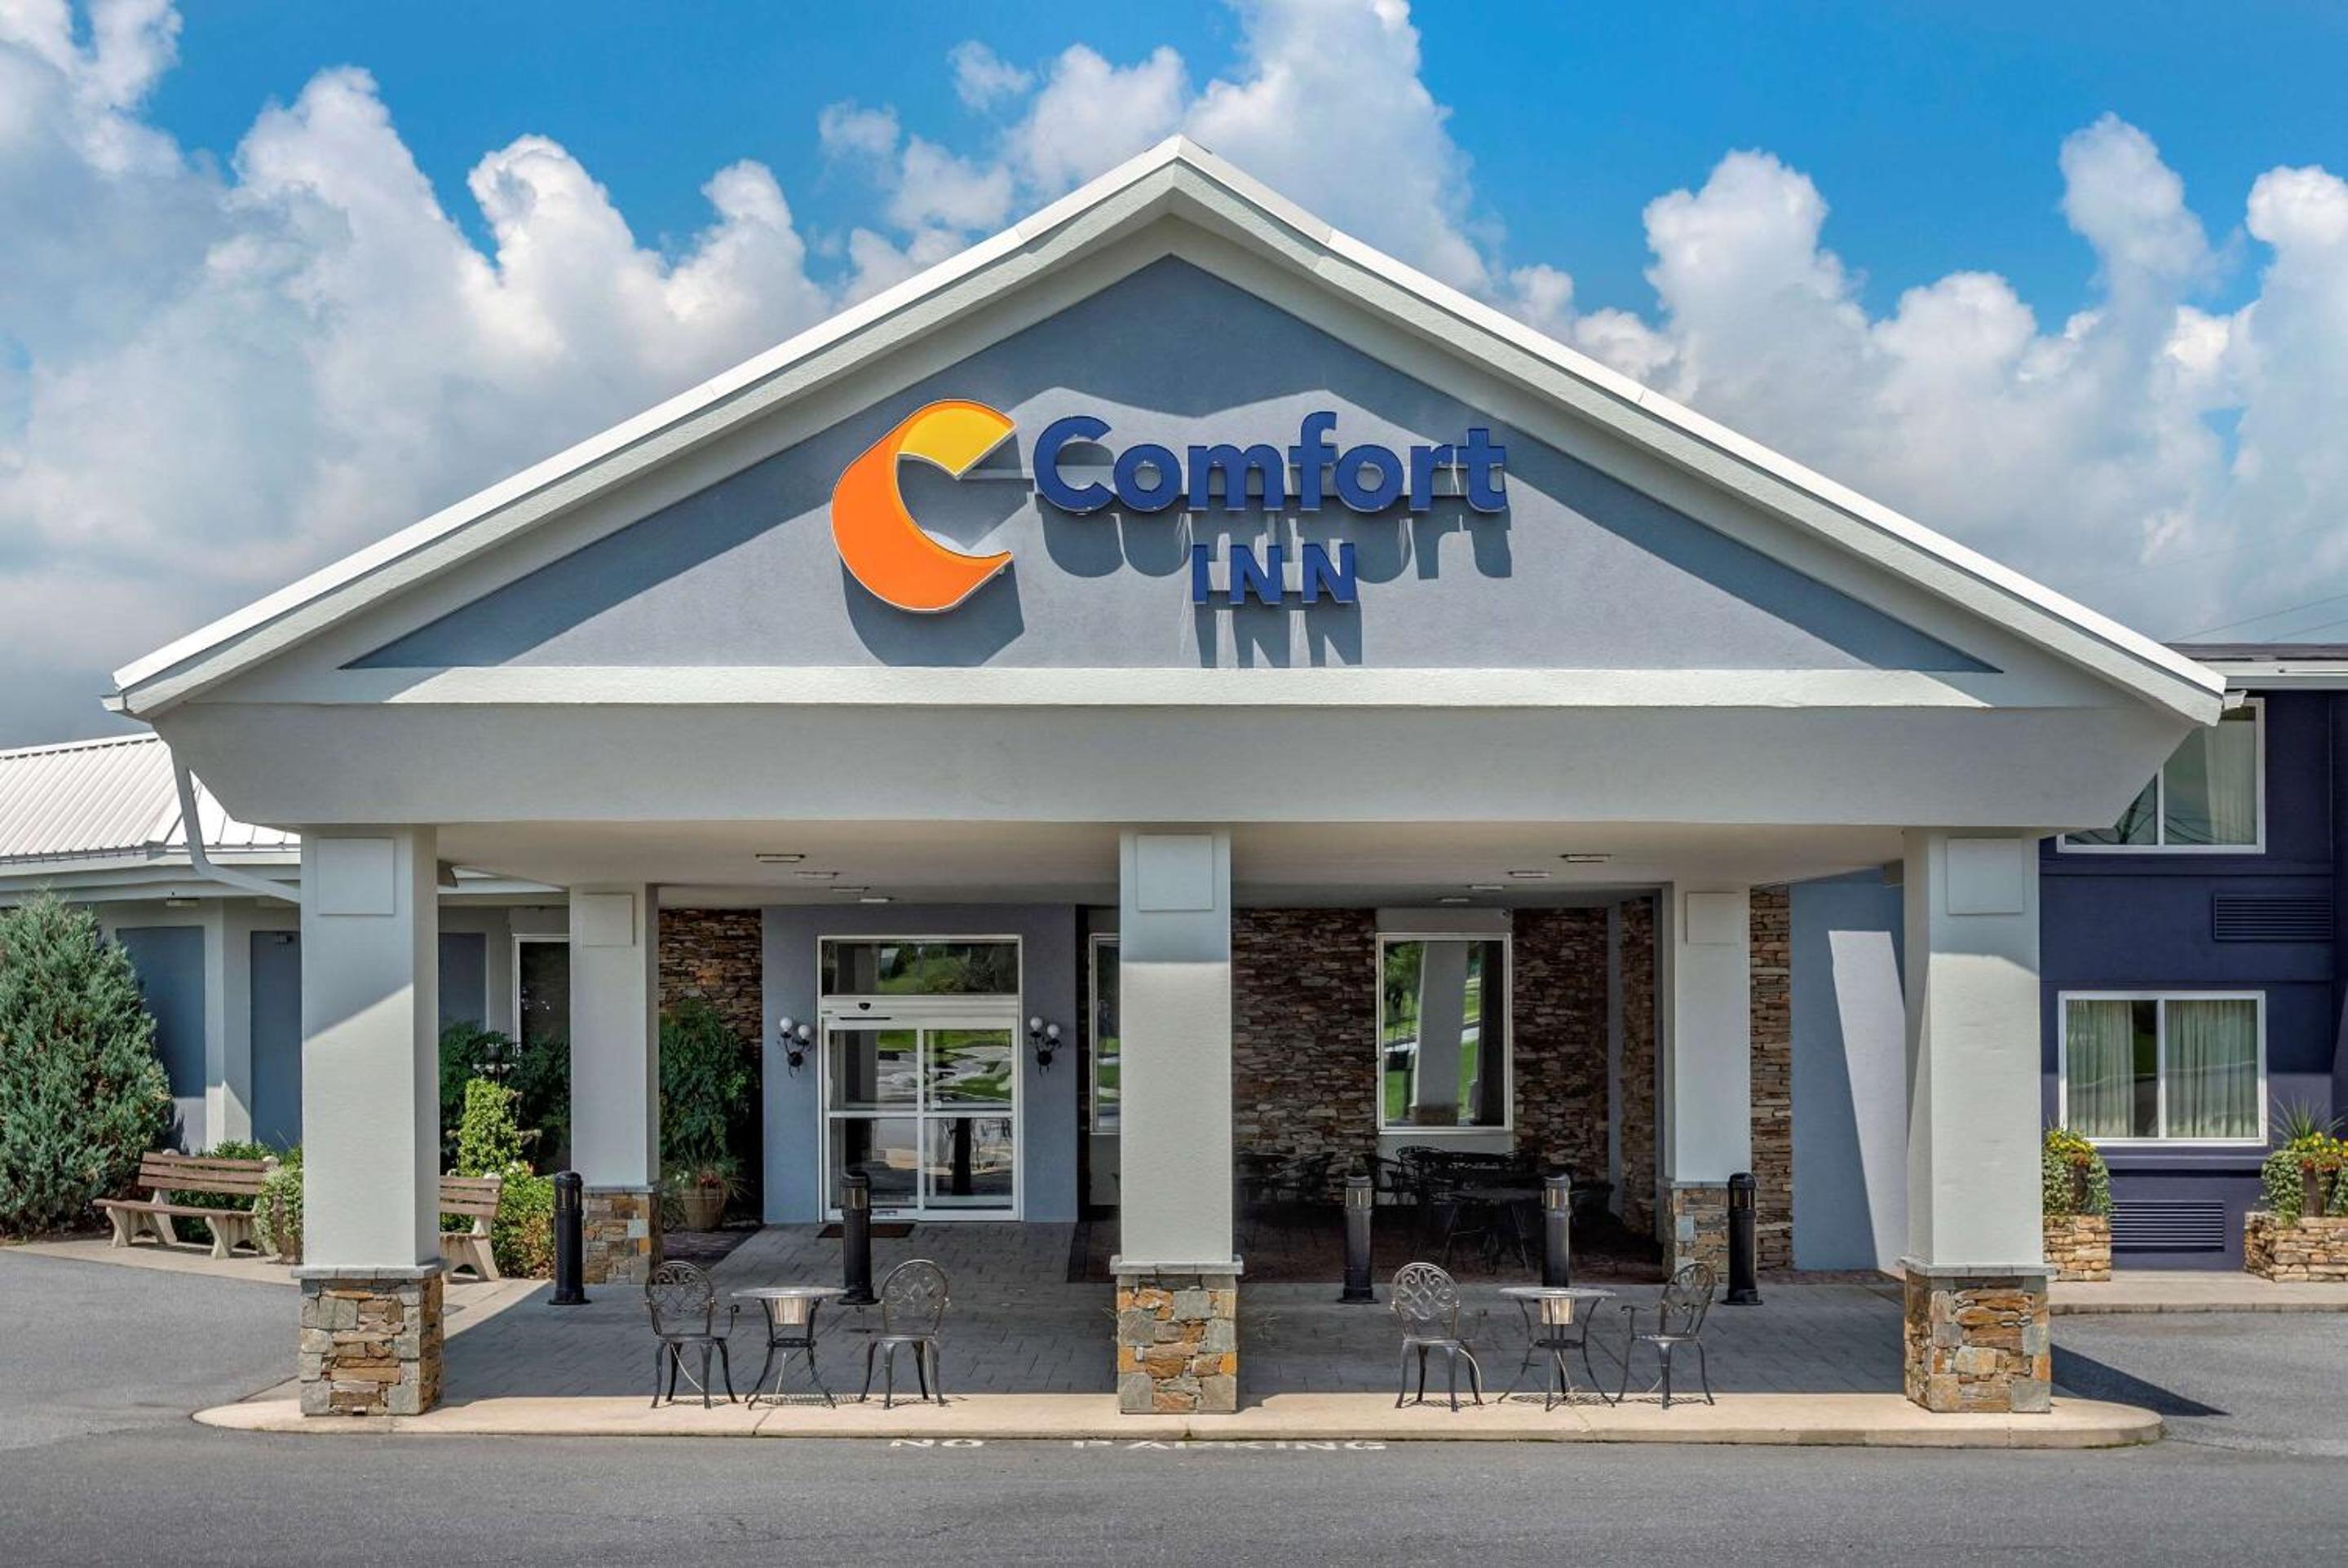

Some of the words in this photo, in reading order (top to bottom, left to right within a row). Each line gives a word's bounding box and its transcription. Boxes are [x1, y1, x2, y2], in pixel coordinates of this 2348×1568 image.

[1033, 410, 1508, 513] Comfort
[1192, 542, 1356, 604] INN
[889, 1439, 984, 1448] NO
[1072, 1440, 1387, 1451] PARKING
